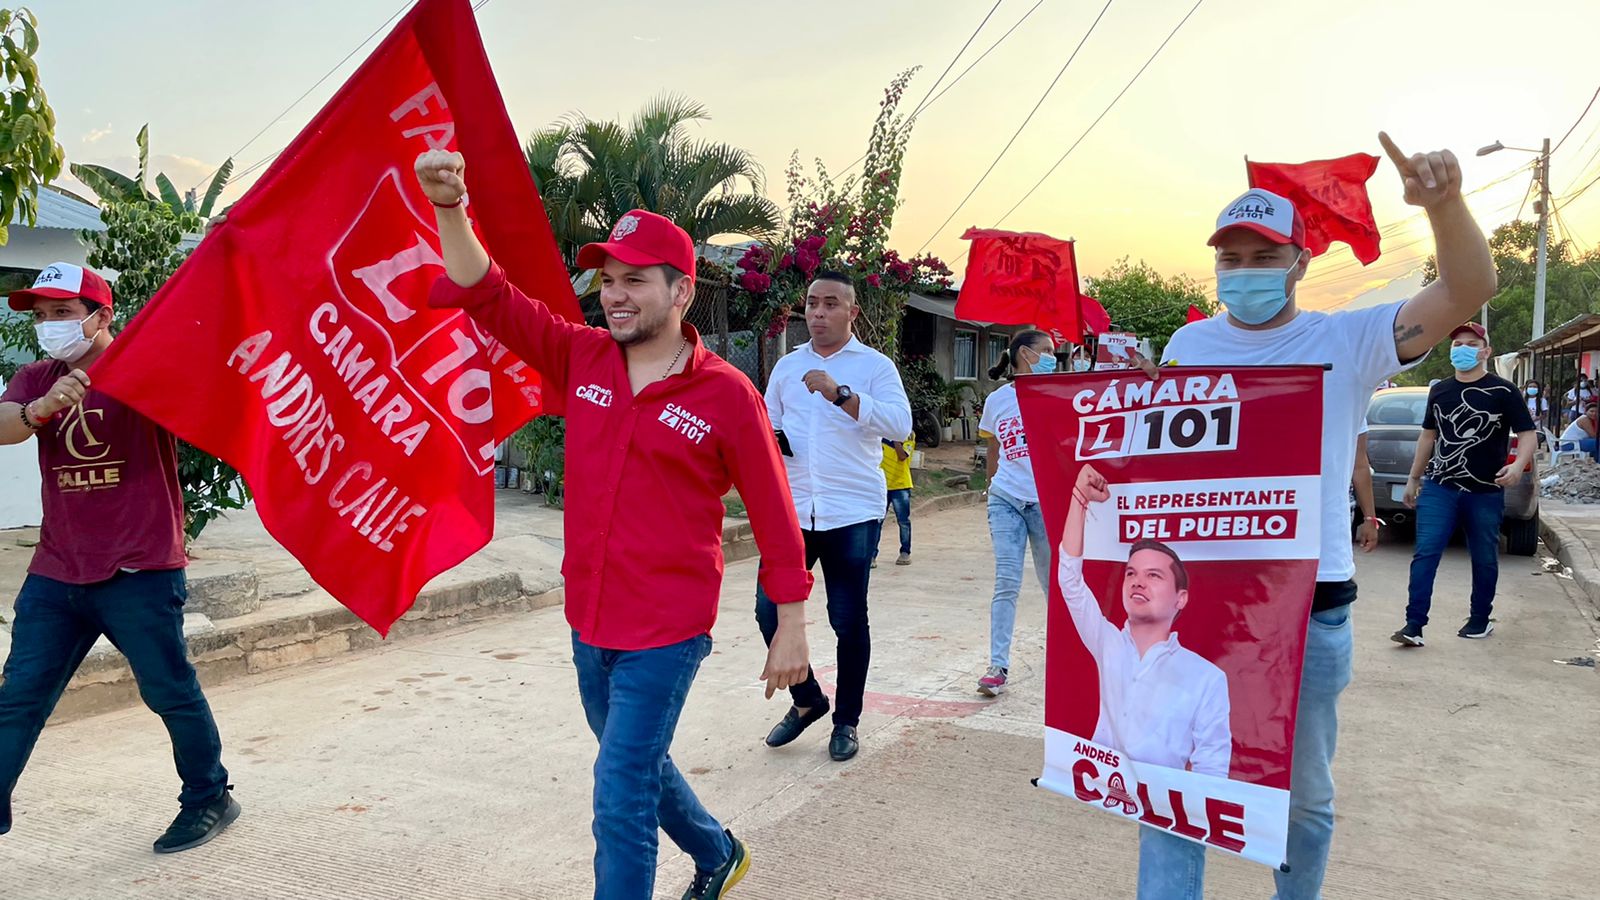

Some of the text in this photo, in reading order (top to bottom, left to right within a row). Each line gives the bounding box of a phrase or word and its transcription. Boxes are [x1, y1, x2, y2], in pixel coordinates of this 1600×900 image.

[1228, 204, 1276, 217] CALLE
[1246, 211, 1264, 220] 101
[309, 301, 431, 457] CAMARA
[421, 327, 495, 462] 10
[1072, 373, 1239, 414] CÁMARA
[665, 402, 712, 434] CÁMARA
[998, 418, 1021, 433] CA
[1089, 405, 1233, 451] L 101
[226, 330, 428, 553] ANDRES CALLE
[681, 421, 705, 445] 101
[57, 468, 120, 488] CALLE
[1117, 489, 1297, 511] EL REPRESENTANTE
[1125, 515, 1288, 539] DEL PUEBLO
[1073, 741, 1121, 769] ANDRÉS
[1071, 758, 1247, 854] CALLE
